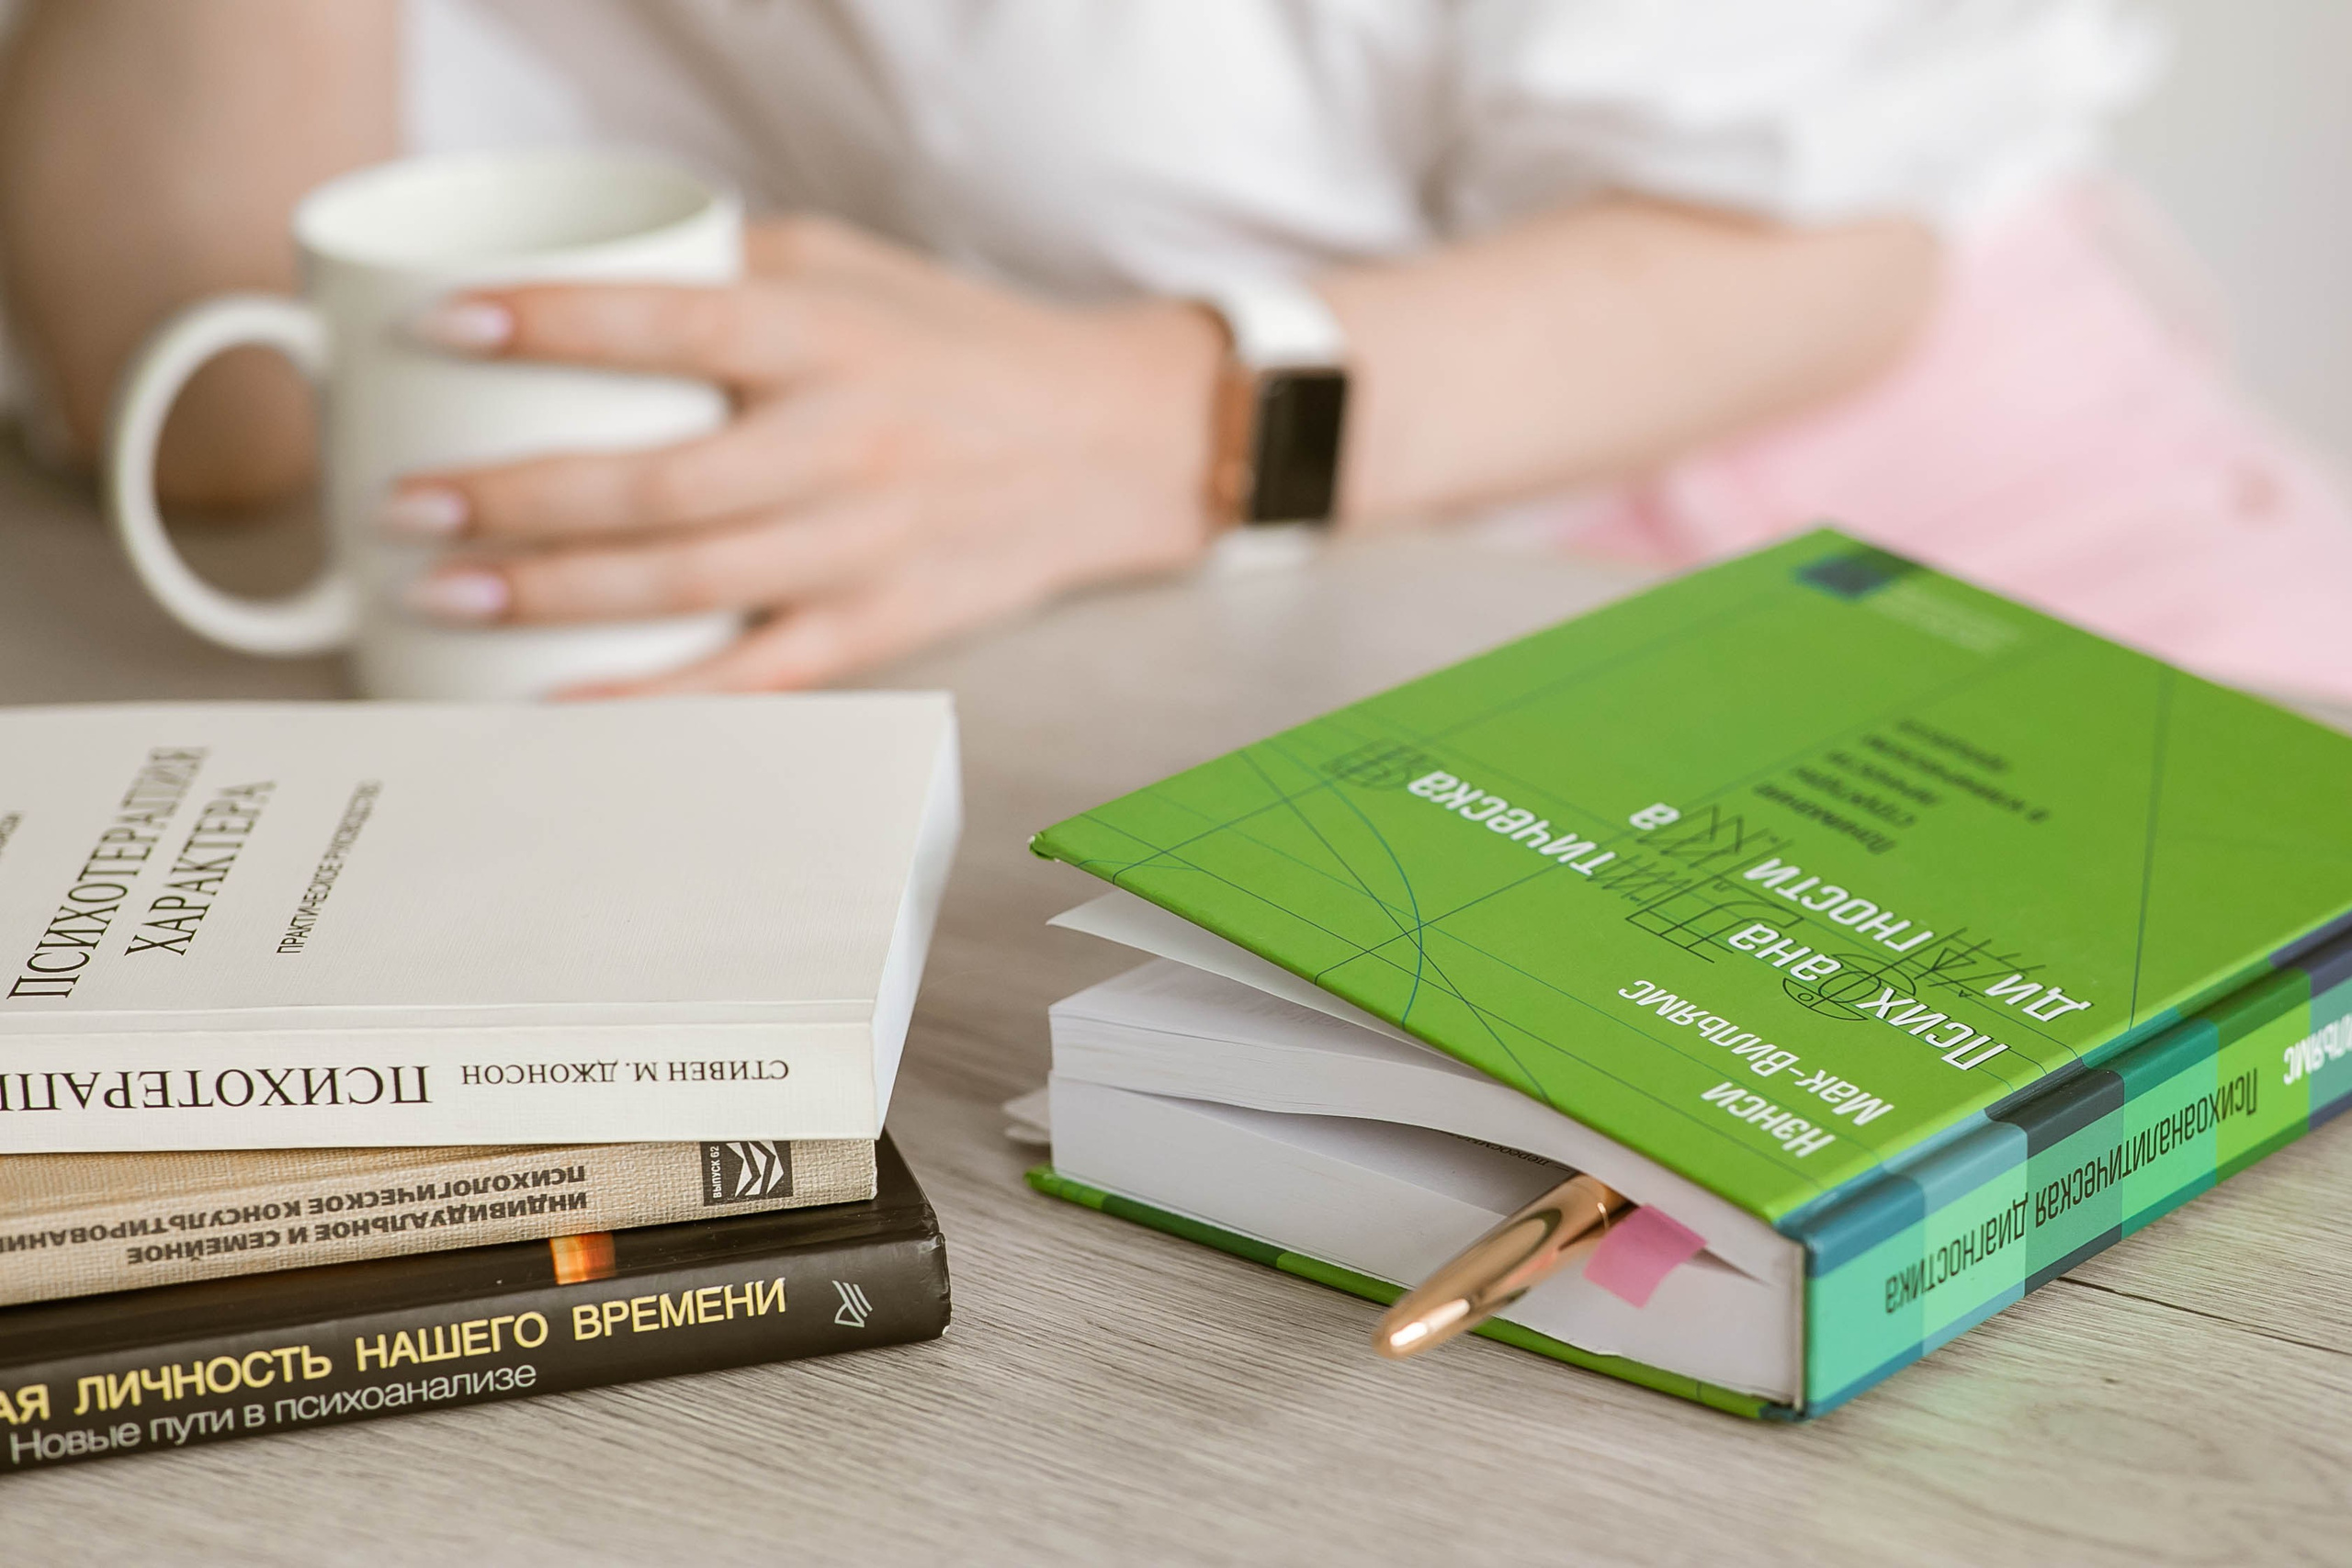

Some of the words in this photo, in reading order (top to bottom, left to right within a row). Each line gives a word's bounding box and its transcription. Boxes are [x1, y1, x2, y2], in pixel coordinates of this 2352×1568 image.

[6, 746, 210, 999] ПСИХОТЕРАПИЯ
[124, 780, 277, 956] ХАРАКТЕРА
[276, 860, 345, 954] ПРАКТИЧЕСКОЕ
[461, 1059, 619, 1085] ДЖОНСОН
[625, 1061, 658, 1082] М.
[670, 1059, 789, 1082] СТИВЕН
[1618, 979, 1894, 1126] Мак-Вильямс
[1701, 1081, 1837, 1158] Нэнси
[709, 1145, 720, 1158] 62
[2034, 1067, 2259, 1228] Психоаналитическая
[309, 1165, 585, 1214] ПСИХОЛОГИЧЕСКОЕ
[710, 1159, 723, 1199] ВЫПУСК
[0, 1200, 301, 1254] КОНСУЛЬТИРОВАНИ
[288, 1226, 308, 1245] И
[315, 1192, 587, 1240] ИНДИВИДУАЛЬНОЕ
[128, 1229, 281, 1266] СЕМЕЙНОЕ
[74, 1345, 333, 1416] ЛИЧНОСТЬ
[355, 1311, 548, 1371] НАШЕГО
[571, 1277, 787, 1341] ВРЕМЕНИ
[9, 1422, 141, 1464] Новые
[150, 1406, 235, 1446] пути
[243, 1404, 266, 1428] в
[275, 1364, 537, 1425] психоанализе
